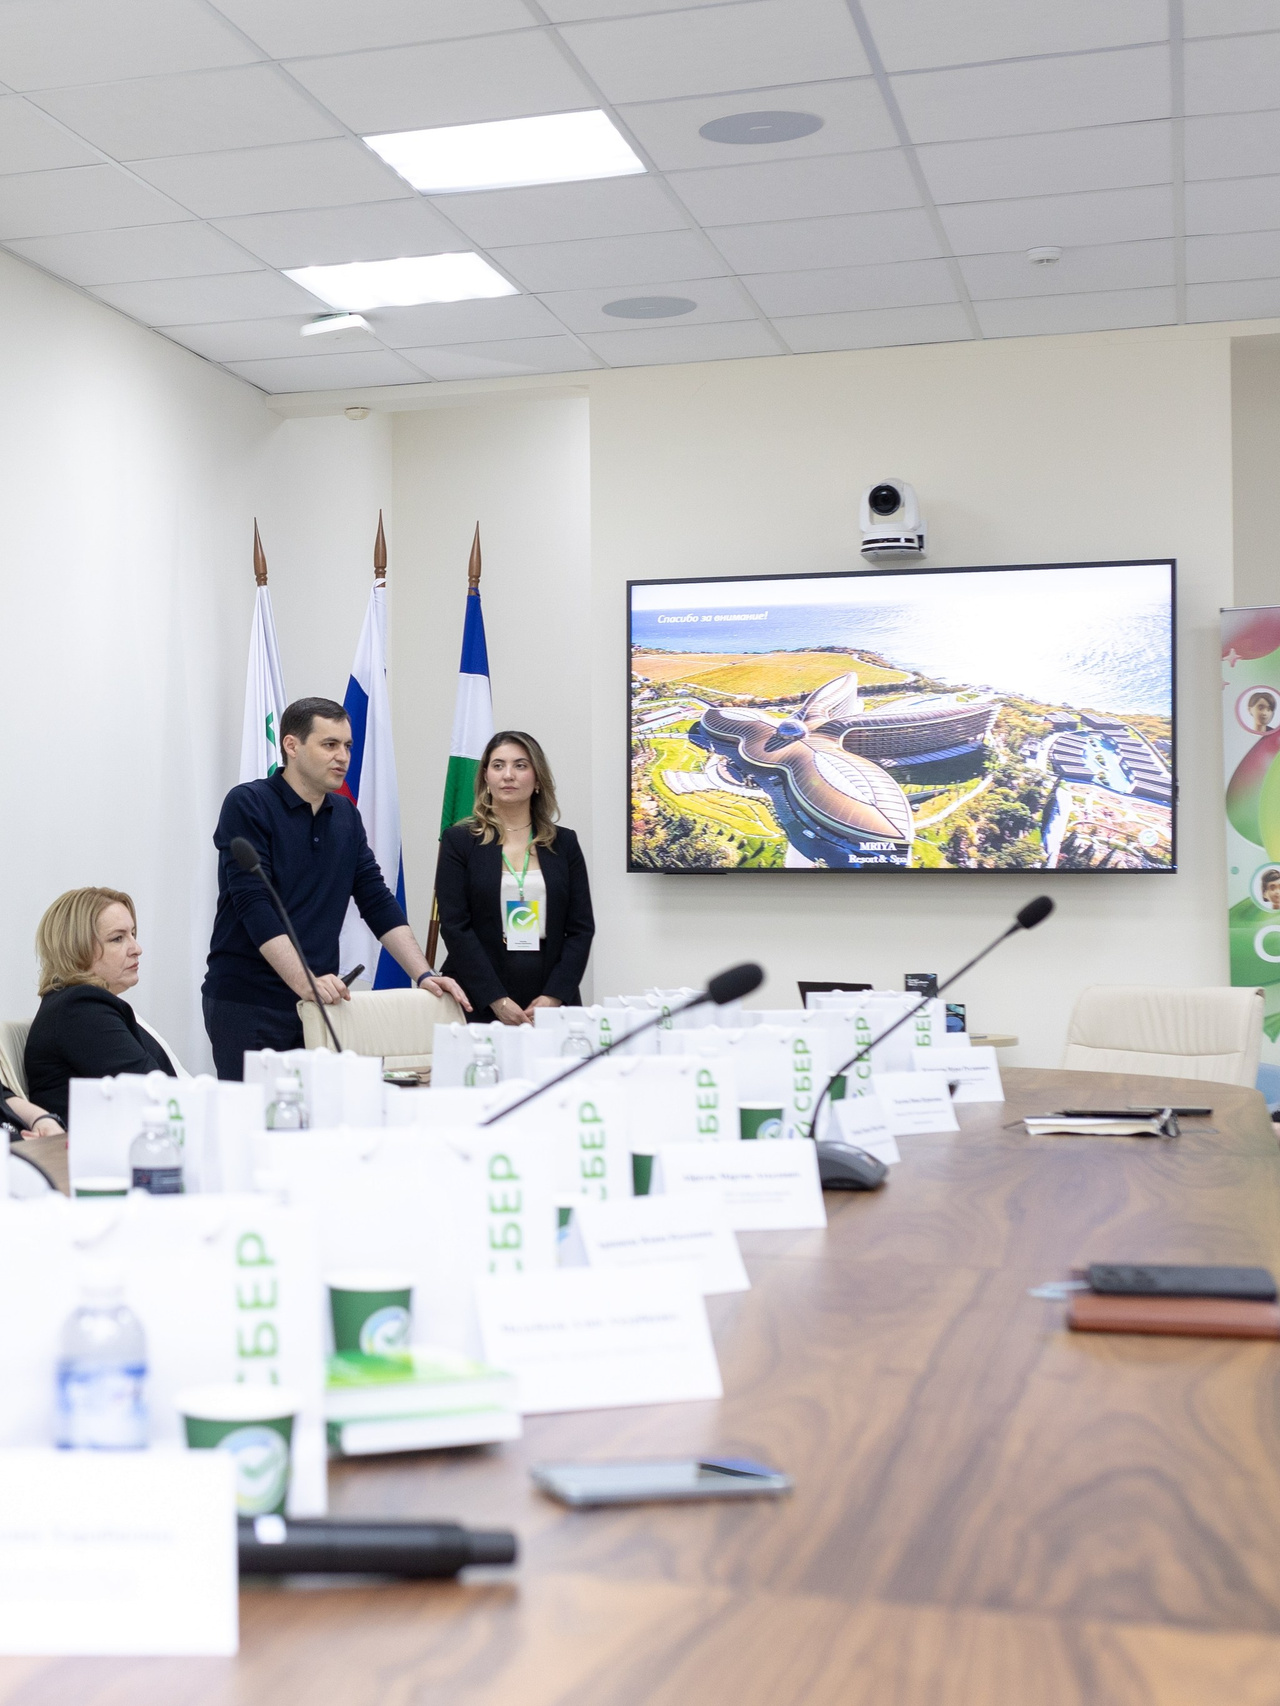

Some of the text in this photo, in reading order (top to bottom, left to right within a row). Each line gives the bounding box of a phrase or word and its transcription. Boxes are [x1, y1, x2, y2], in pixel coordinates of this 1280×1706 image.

[657, 611, 769, 624] Спасибо за внимание!
[859, 842, 897, 851] MRIYA
[848, 854, 878, 864] Resort
[879, 854, 888, 863] &
[793, 1038, 812, 1112] СБЕР
[696, 1068, 719, 1142] БЕР
